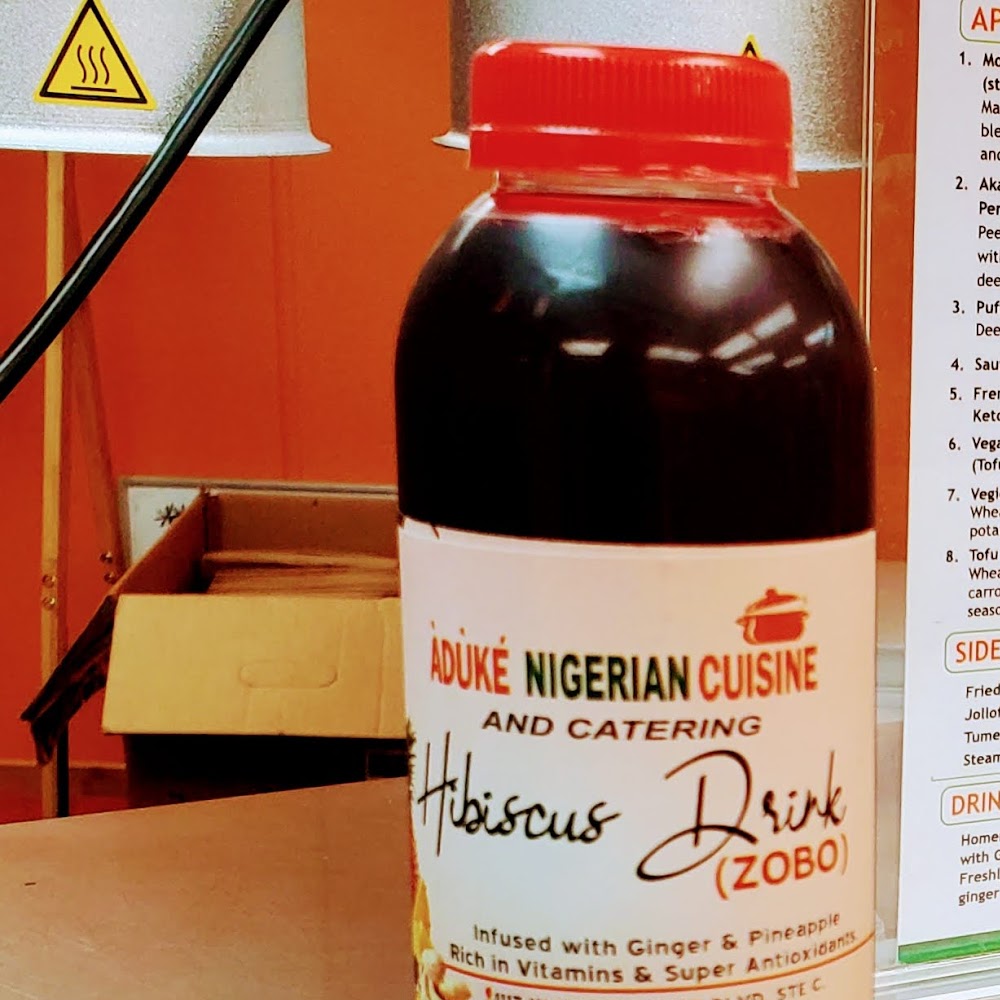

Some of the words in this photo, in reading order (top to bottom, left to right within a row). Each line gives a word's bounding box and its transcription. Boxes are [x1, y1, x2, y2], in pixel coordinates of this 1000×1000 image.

[959, 52, 972, 66] 1.
[955, 177, 968, 191] 2.
[953, 301, 965, 314] 3.
[951, 359, 964, 372] 4.
[950, 388, 962, 402] 5.
[949, 438, 961, 450] 6.
[947, 489, 960, 501] 7.
[946, 550, 959, 563] 8.
[969, 548, 999, 563] Tofu
[525, 651, 691, 701] NIGERIAN
[699, 645, 818, 702] CUISINE
[965, 684, 1000, 699] Fried
[482, 711, 555, 737] AND
[567, 715, 763, 741] CATERING
[418, 730, 623, 857] Hibiscus
[636, 748, 848, 881] Drink
[715, 832, 849, 900] (ZOBO)
[473, 924, 551, 953] Infused
[562, 939, 617, 956] with
[627, 938, 712, 959] Ginger
[722, 934, 738, 951] &
[749, 912, 841, 946] Pineapple
[450, 944, 485, 969] Rich
[492, 955, 509, 974] in
[518, 958, 623, 983] Vitamins
[634, 966, 652, 983] &
[666, 963, 735, 983] Super
[747, 930, 858, 973] Antioxidants
